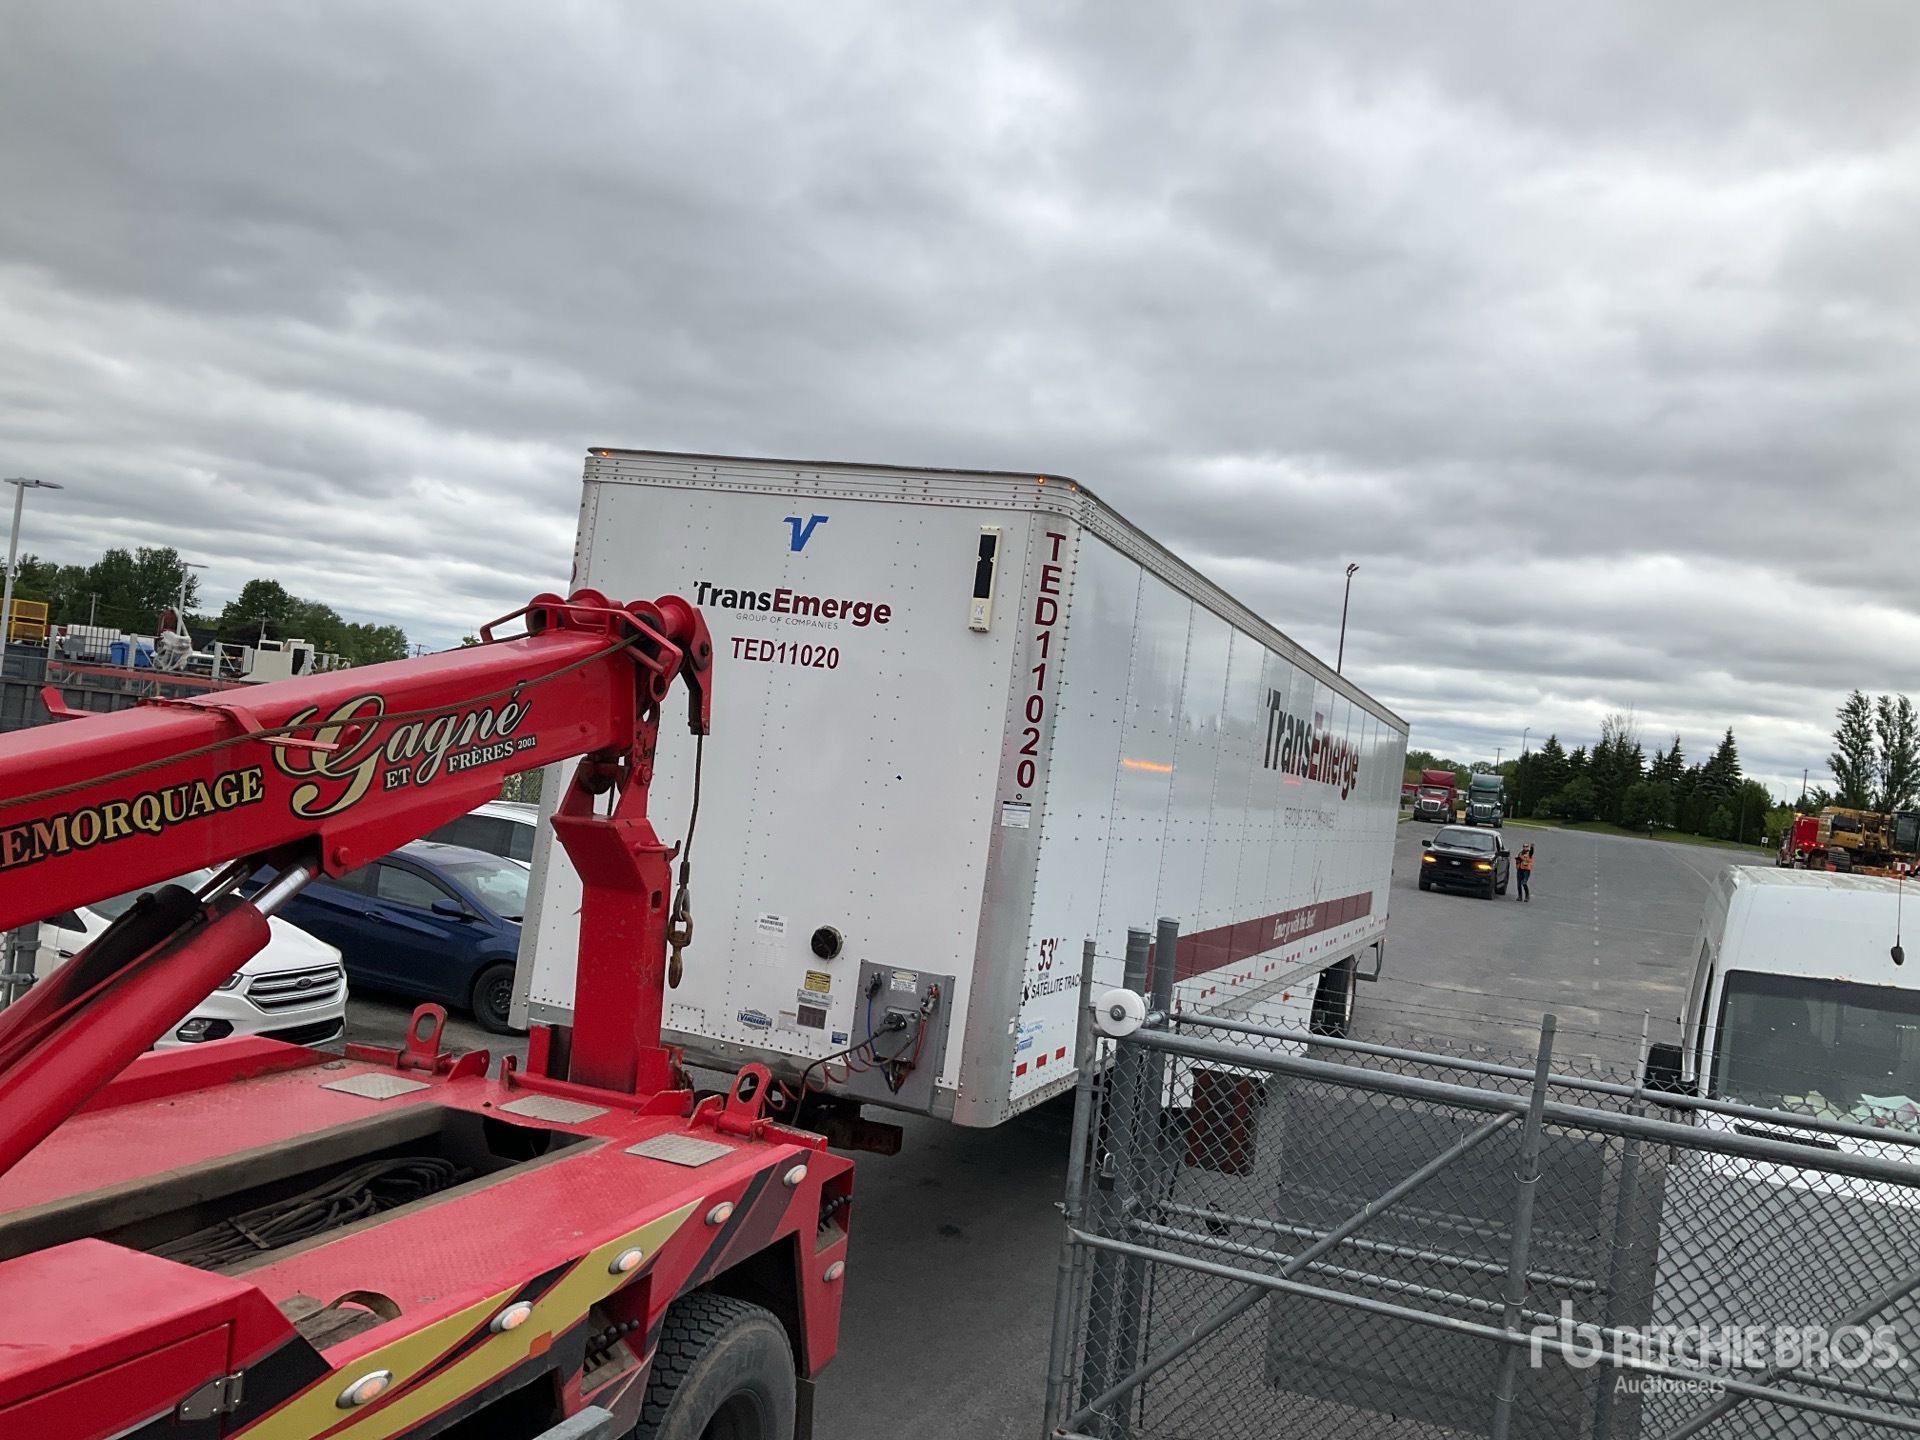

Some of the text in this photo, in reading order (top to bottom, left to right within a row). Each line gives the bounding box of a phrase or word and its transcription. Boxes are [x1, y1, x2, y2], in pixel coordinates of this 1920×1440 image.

[693, 581, 892, 627] TransEmerge
[736, 612, 839, 630] GROUP OF COMPANIES
[731, 637, 840, 669] TED11020
[1015, 531, 1067, 788] TED11020
[384, 737, 536, 790] ET FRÈRES 2001
[1264, 687, 1359, 801] TransEmerge
[1031, 977, 1063, 999] SATELLITE
